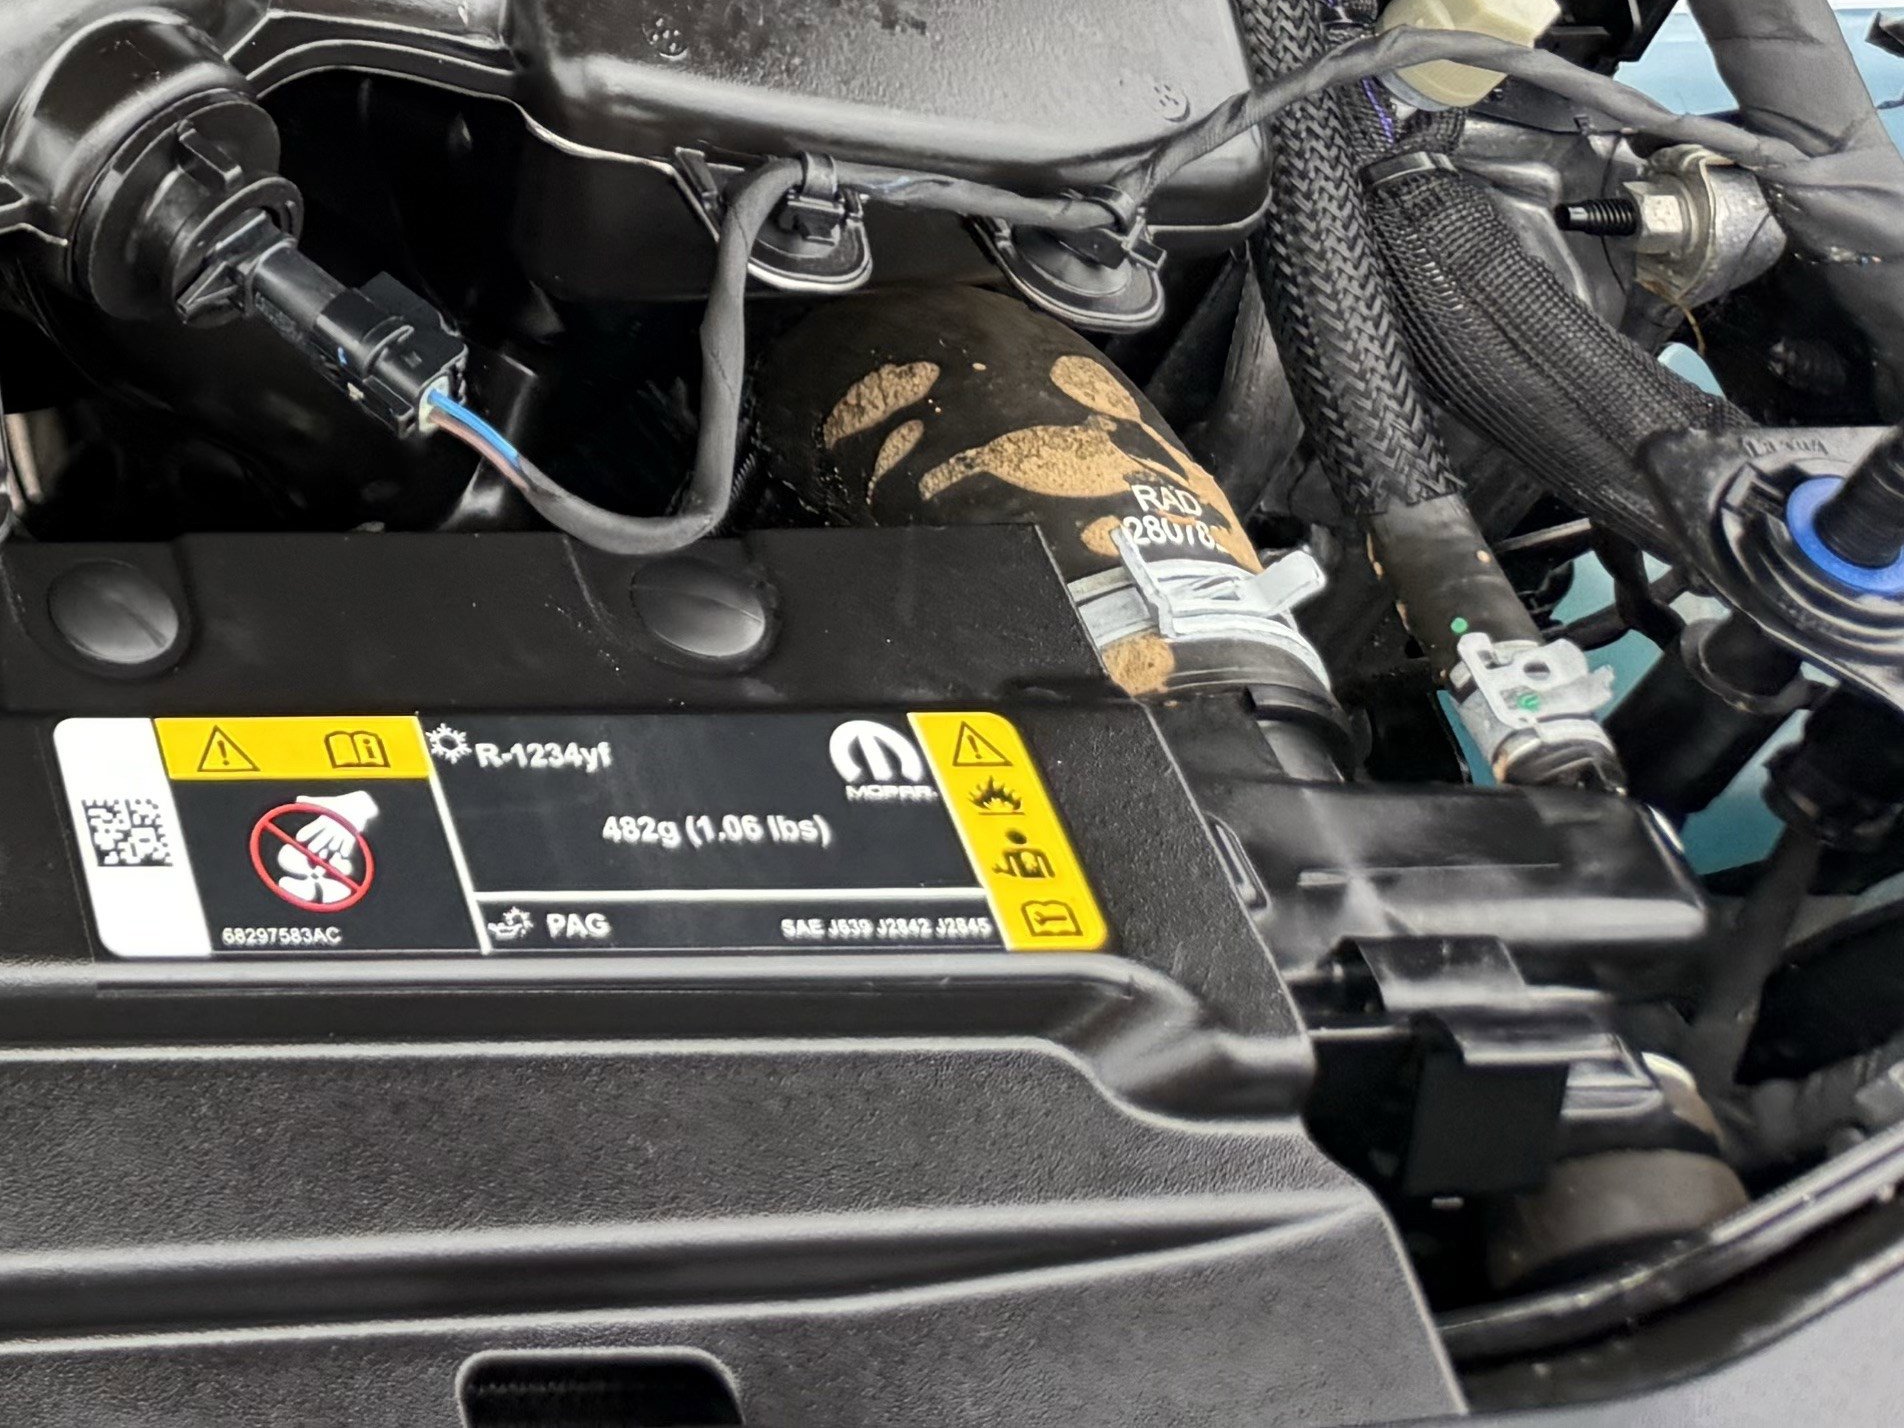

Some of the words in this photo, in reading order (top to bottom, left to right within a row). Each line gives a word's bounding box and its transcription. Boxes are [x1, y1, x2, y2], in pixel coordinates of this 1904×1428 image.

[1132, 485, 1203, 517] RAD
[475, 741, 613, 773] R-1234yf
[845, 784, 934, 802] MOPAR
[602, 815, 681, 848] 482g
[685, 814, 765, 848] (1.06
[766, 813, 833, 849] lbs)
[222, 926, 343, 947] 68297583AC
[546, 912, 612, 939] PAG
[781, 918, 825, 940] SAE
[828, 917, 874, 940] J639
[876, 917, 933, 940] J2842
[936, 917, 993, 940] J2845
